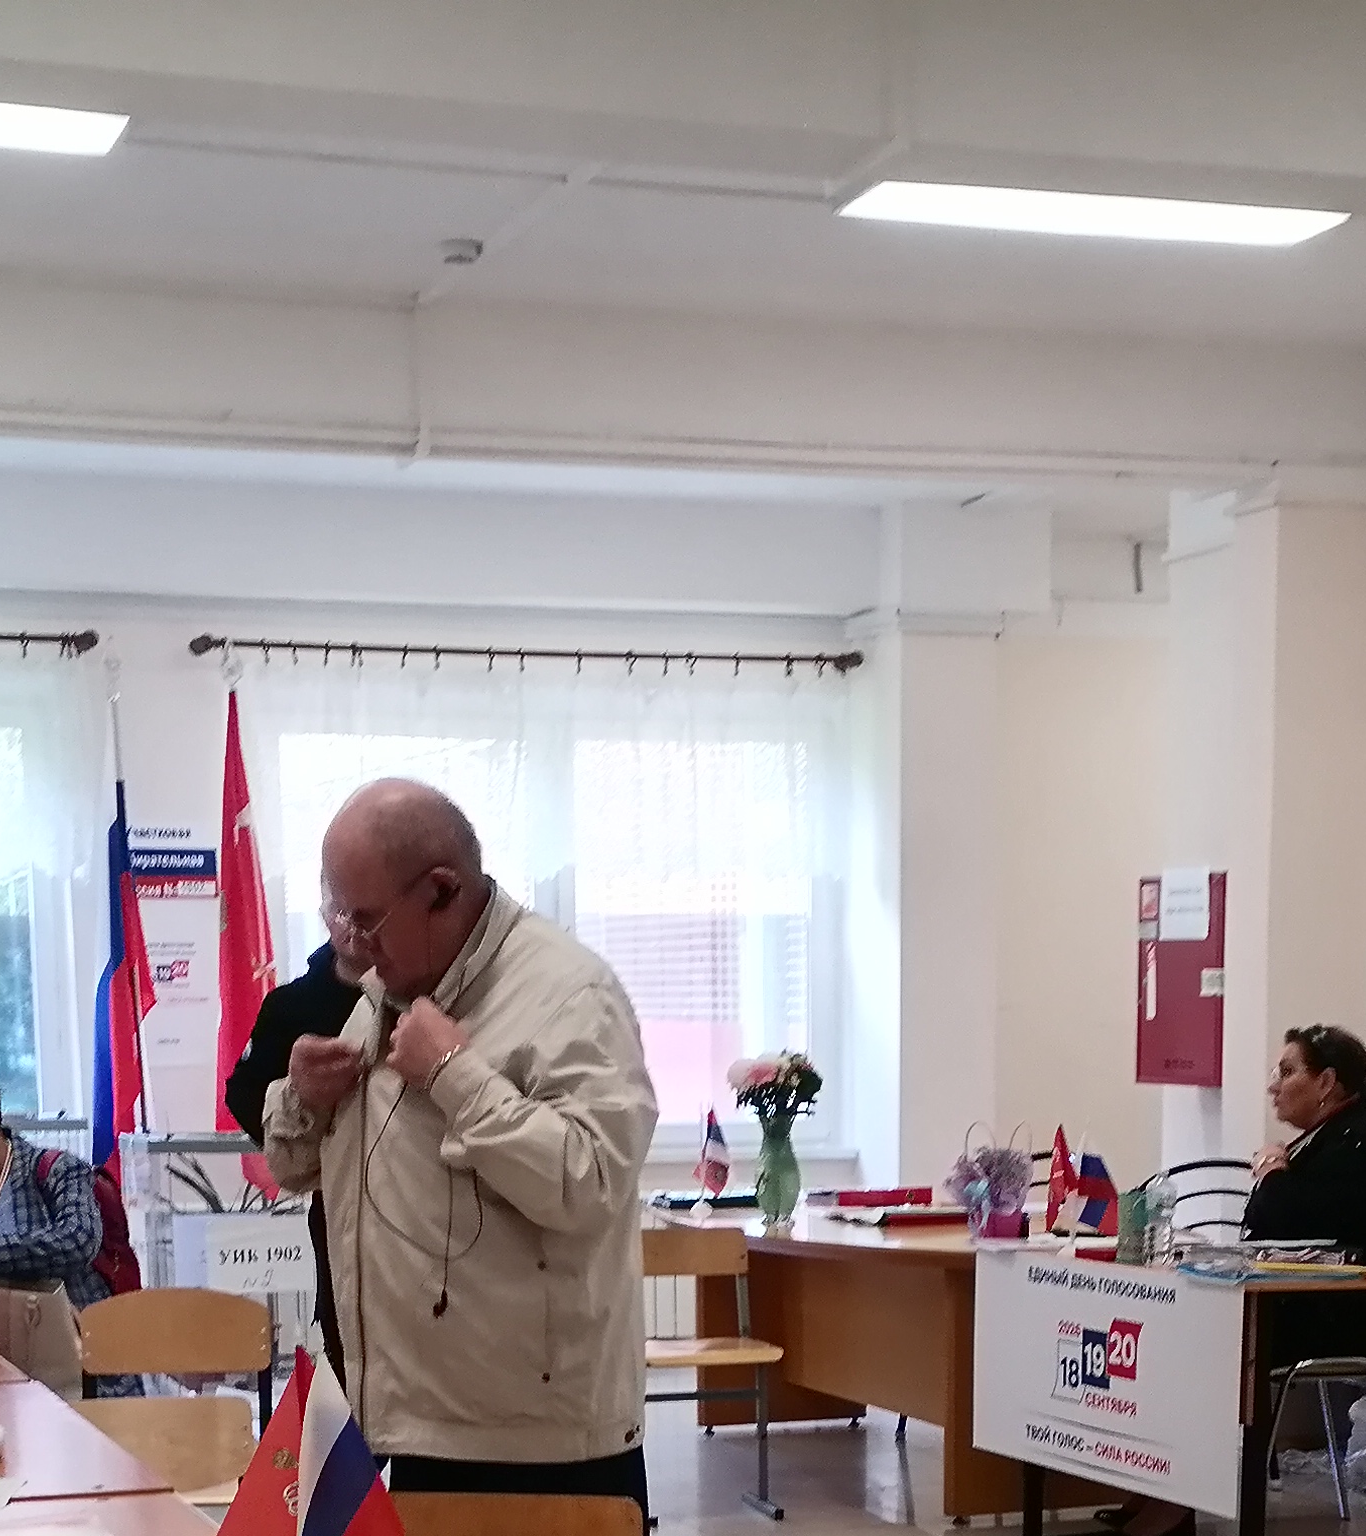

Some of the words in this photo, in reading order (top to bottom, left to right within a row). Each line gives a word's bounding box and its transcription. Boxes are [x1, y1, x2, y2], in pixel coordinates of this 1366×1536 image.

[218, 1248, 259, 1266] УИК
[266, 1245, 303, 1263] 1902
[1028, 1264, 1069, 1288] ЕДИНЫЙ
[1069, 1272, 1097, 1292] ДЕНЬ
[1098, 1276, 1177, 1304] ГОЛОСОВАНИЯ
[1060, 1356, 1080, 1388] 18
[1084, 1341, 1106, 1378] 19
[1108, 1330, 1136, 1368] 20
[1085, 1391, 1138, 1419] СЕНТЯБРЯ
[1051, 1430, 1085, 1452] ГОЛОС
[1095, 1440, 1123, 1463] СИЛА
